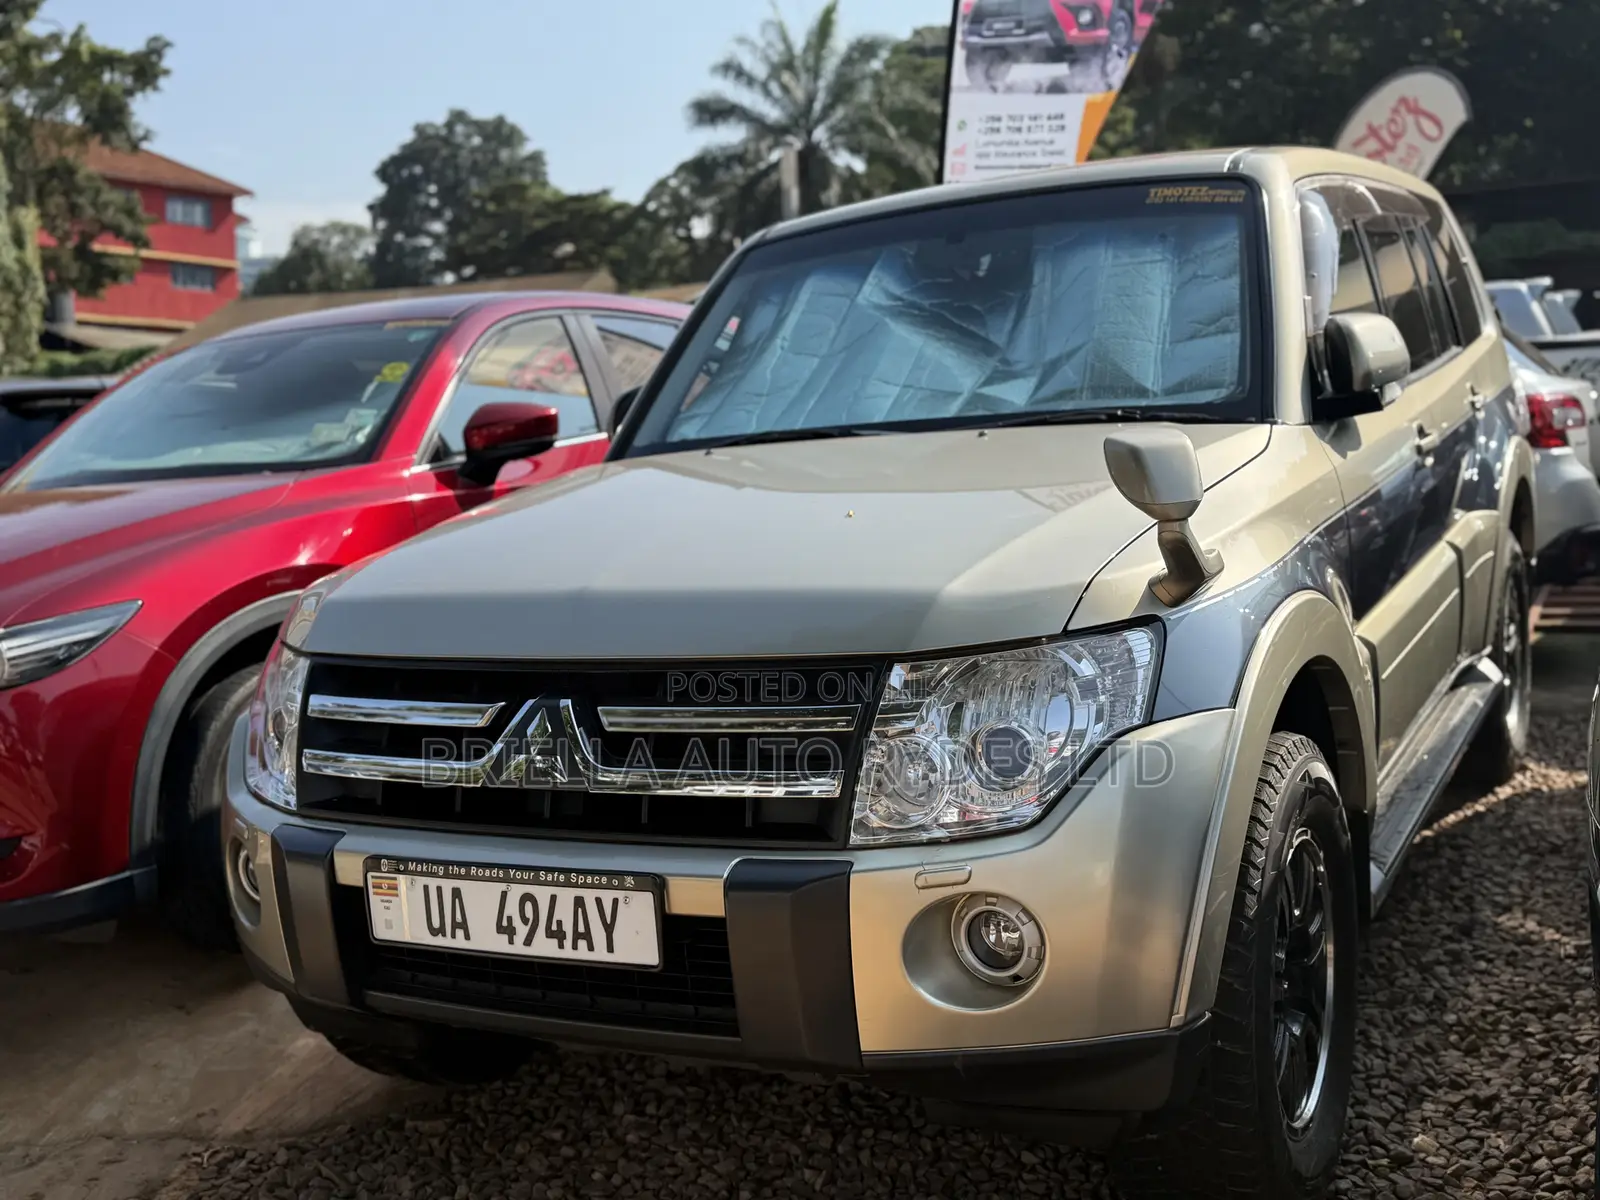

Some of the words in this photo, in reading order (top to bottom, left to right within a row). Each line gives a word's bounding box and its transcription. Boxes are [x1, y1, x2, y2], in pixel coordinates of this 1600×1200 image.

[408, 861, 444, 876] Making
[449, 865, 466, 875] the
[470, 866, 504, 878] Roads
[509, 868, 534, 881] Your
[539, 870, 565, 882] Safe
[570, 872, 608, 886] Space
[423, 884, 471, 941] UA
[495, 890, 619, 953] 494AY
